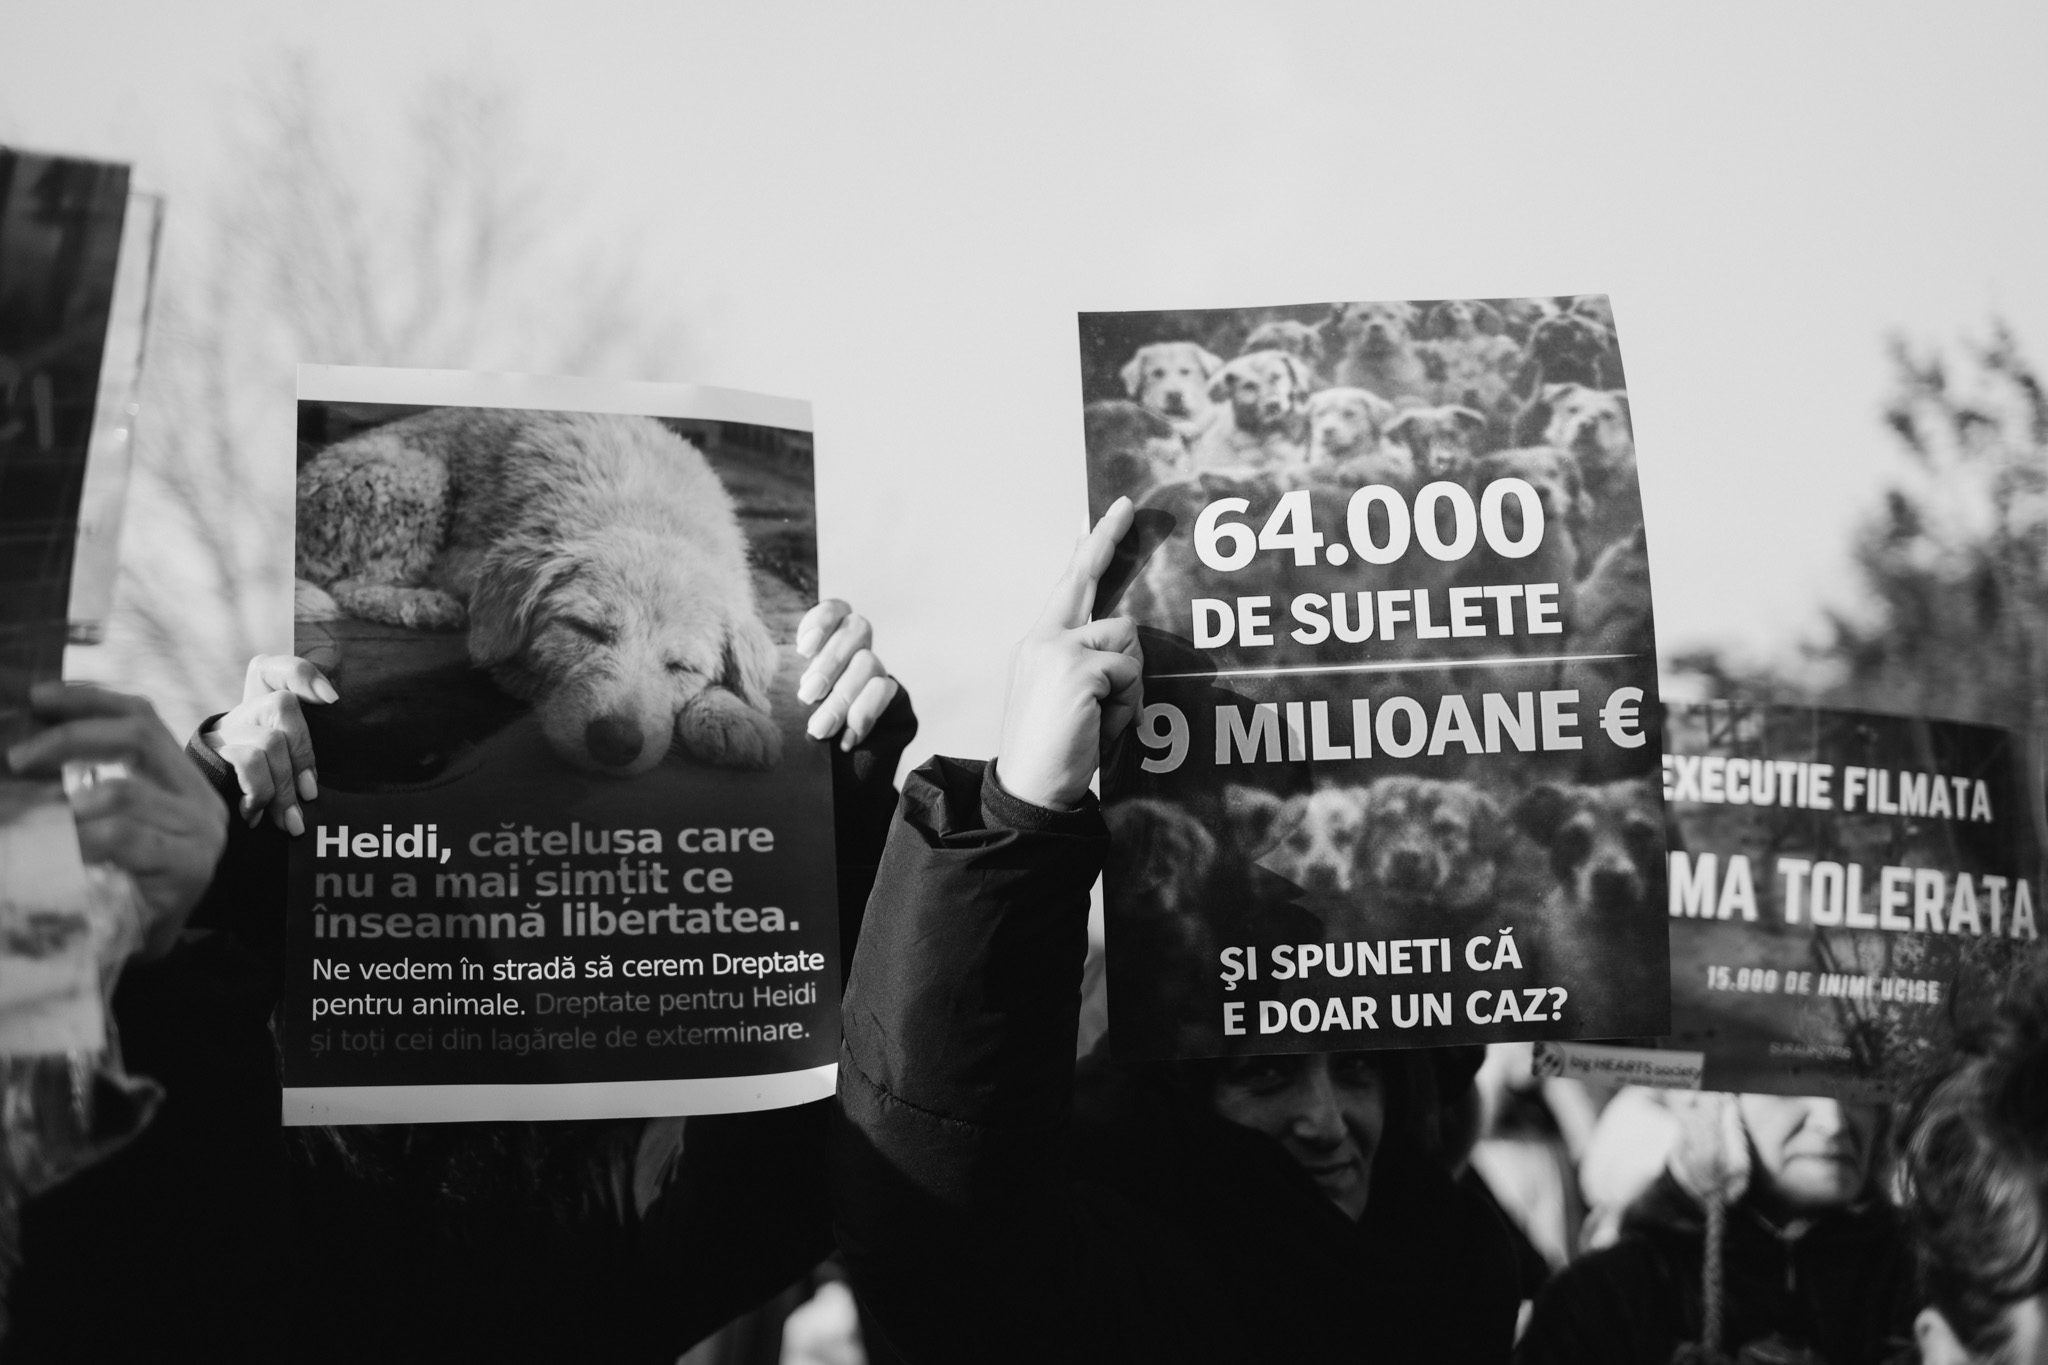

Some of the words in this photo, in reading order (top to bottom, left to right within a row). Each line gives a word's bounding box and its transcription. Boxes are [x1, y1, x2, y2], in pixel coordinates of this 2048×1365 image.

[1194, 477, 1545, 572] 64.000
[1191, 596, 1274, 649] DE
[1290, 583, 1563, 645] SUFLETE
[1136, 703, 1189, 774] 9
[1215, 690, 1583, 765] MILIOANE
[1600, 686, 1646, 748] €
[1843, 765, 1993, 824] FILMATA
[315, 823, 452, 864] Heidi,
[677, 825, 775, 854] care
[315, 871, 374, 898] nu
[390, 871, 418, 898] a
[435, 862, 519, 898] mai
[683, 866, 733, 894] ce
[1666, 850, 1758, 922] MA
[1777, 857, 2039, 940] TOLERATA
[313, 903, 546, 939] înseamnă
[563, 902, 800, 938] libertatea.
[313, 958, 350, 980] Ne
[359, 957, 453, 981] vedem
[460, 956, 484, 980] în
[493, 955, 576, 981] stradă
[584, 955, 613, 979] să
[622, 958, 703, 978] cerem
[712, 950, 825, 980] Dreptate
[1271, 938, 1451, 980] SPUNETI
[1465, 927, 1523, 971] CĂ
[312, 995, 403, 1021] pentru
[412, 993, 526, 1015] animale.
[536, 991, 651, 1019] Dreptate
[658, 986, 743, 1018] pentru
[753, 982, 816, 1007] Heidi
[1224, 1002, 1246, 1035] E
[1259, 996, 1379, 1035] DOAR
[1391, 992, 1452, 1028] UN
[1465, 986, 1568, 1024] CAZ?
[395, 1027, 433, 1051] cei
[442, 1027, 482, 1050] din
[492, 1025, 597, 1056] lagărele
[605, 1024, 638, 1048] de
[646, 1019, 810, 1047] exterminare.
